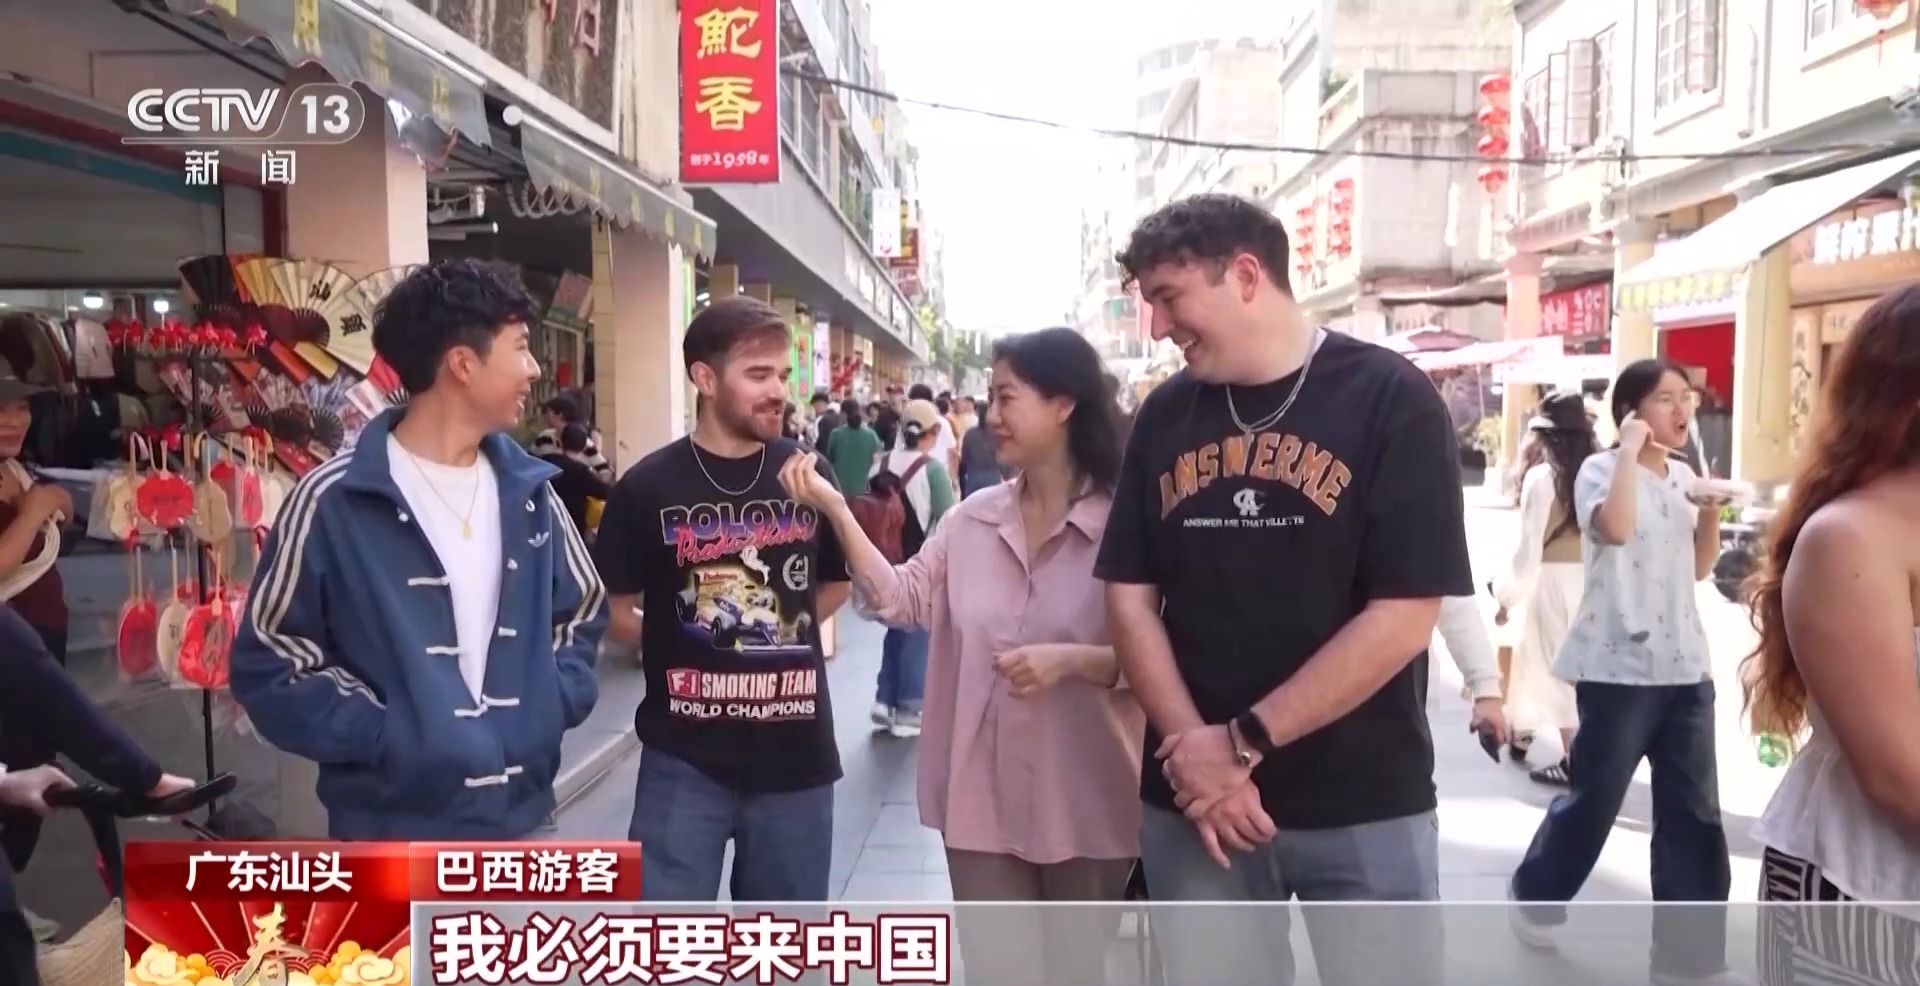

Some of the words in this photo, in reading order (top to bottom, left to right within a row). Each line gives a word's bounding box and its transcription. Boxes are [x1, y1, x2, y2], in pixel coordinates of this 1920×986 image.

[693, 6, 763, 131] 鮀香
[1183, 517, 1222, 528] ANSWER
[702, 672, 777, 699] SMOKING
[781, 669, 817, 695] TEAM
[669, 698, 722, 718] WORLD
[726, 699, 815, 719] CHAMPIONS
